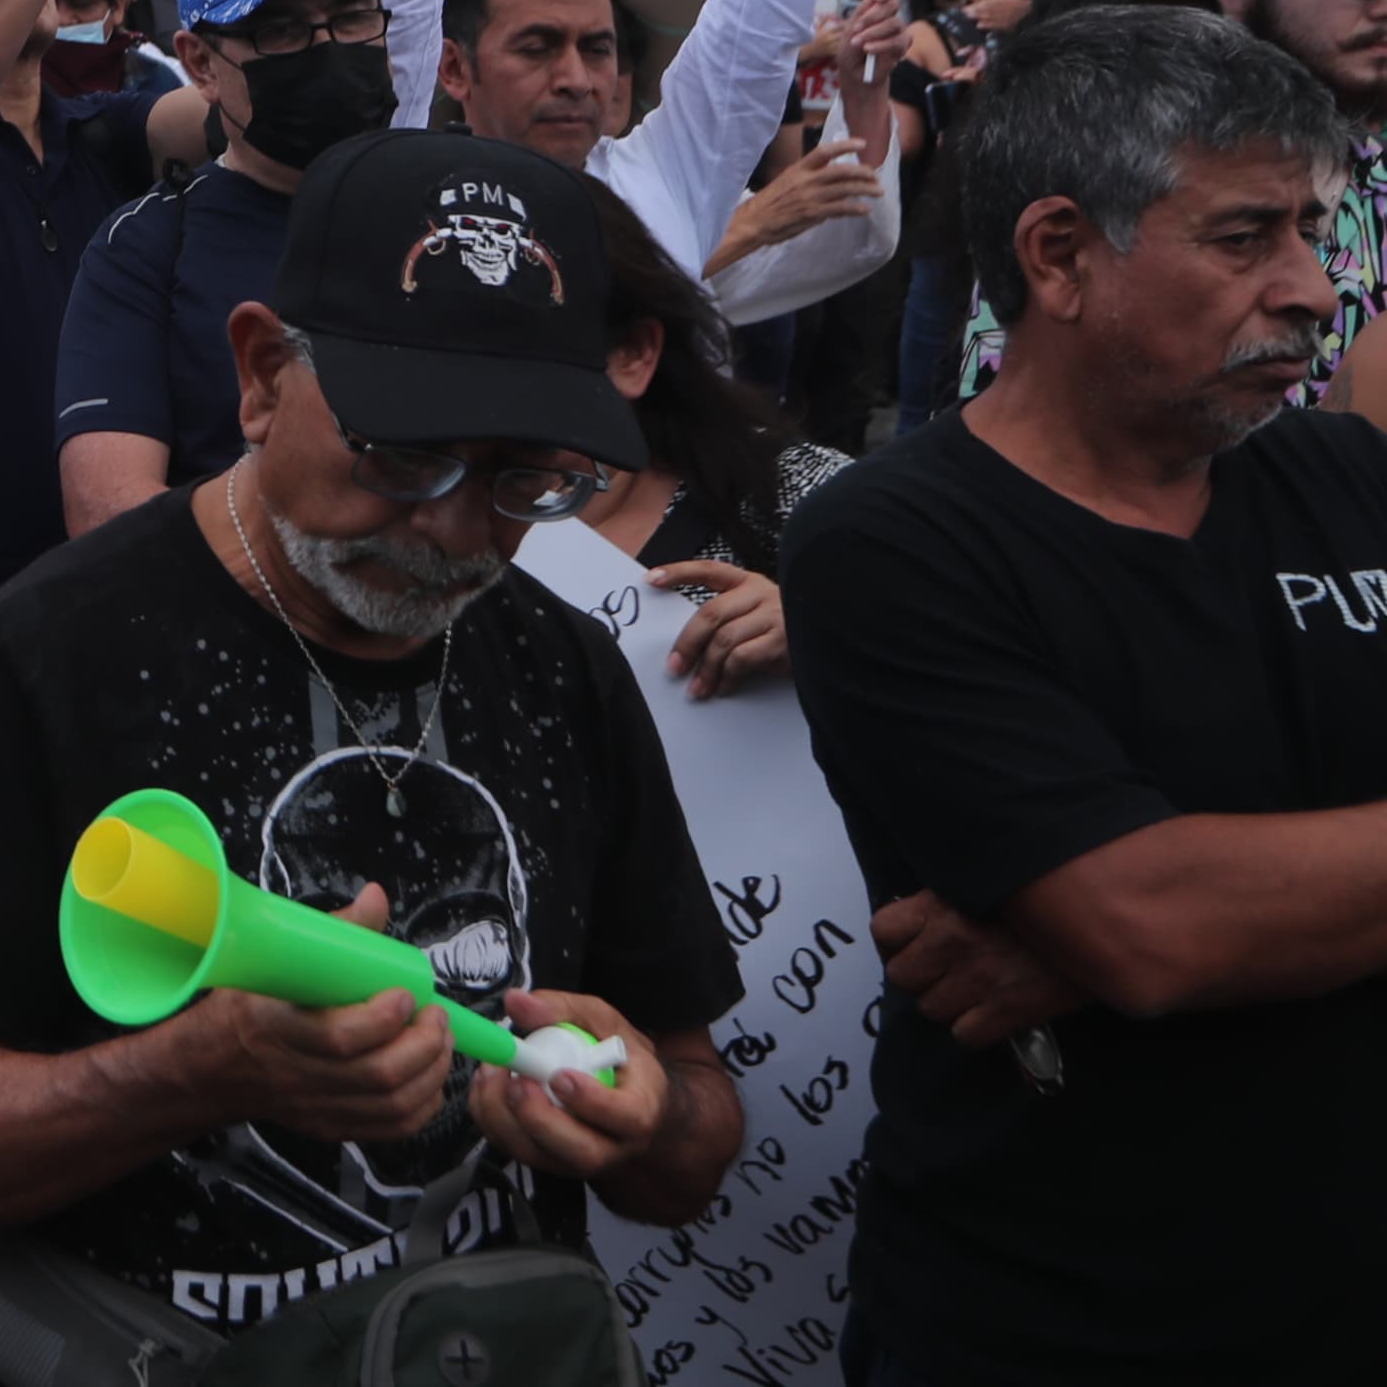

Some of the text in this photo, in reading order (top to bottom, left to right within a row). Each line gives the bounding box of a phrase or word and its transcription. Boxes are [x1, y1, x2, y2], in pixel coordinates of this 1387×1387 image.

[461, 181, 505, 206] PM
[772, 919, 856, 1014] con
[733, 1136, 786, 1196] no
[778, 1054, 849, 1126] los
[702, 1255, 774, 1304] los
